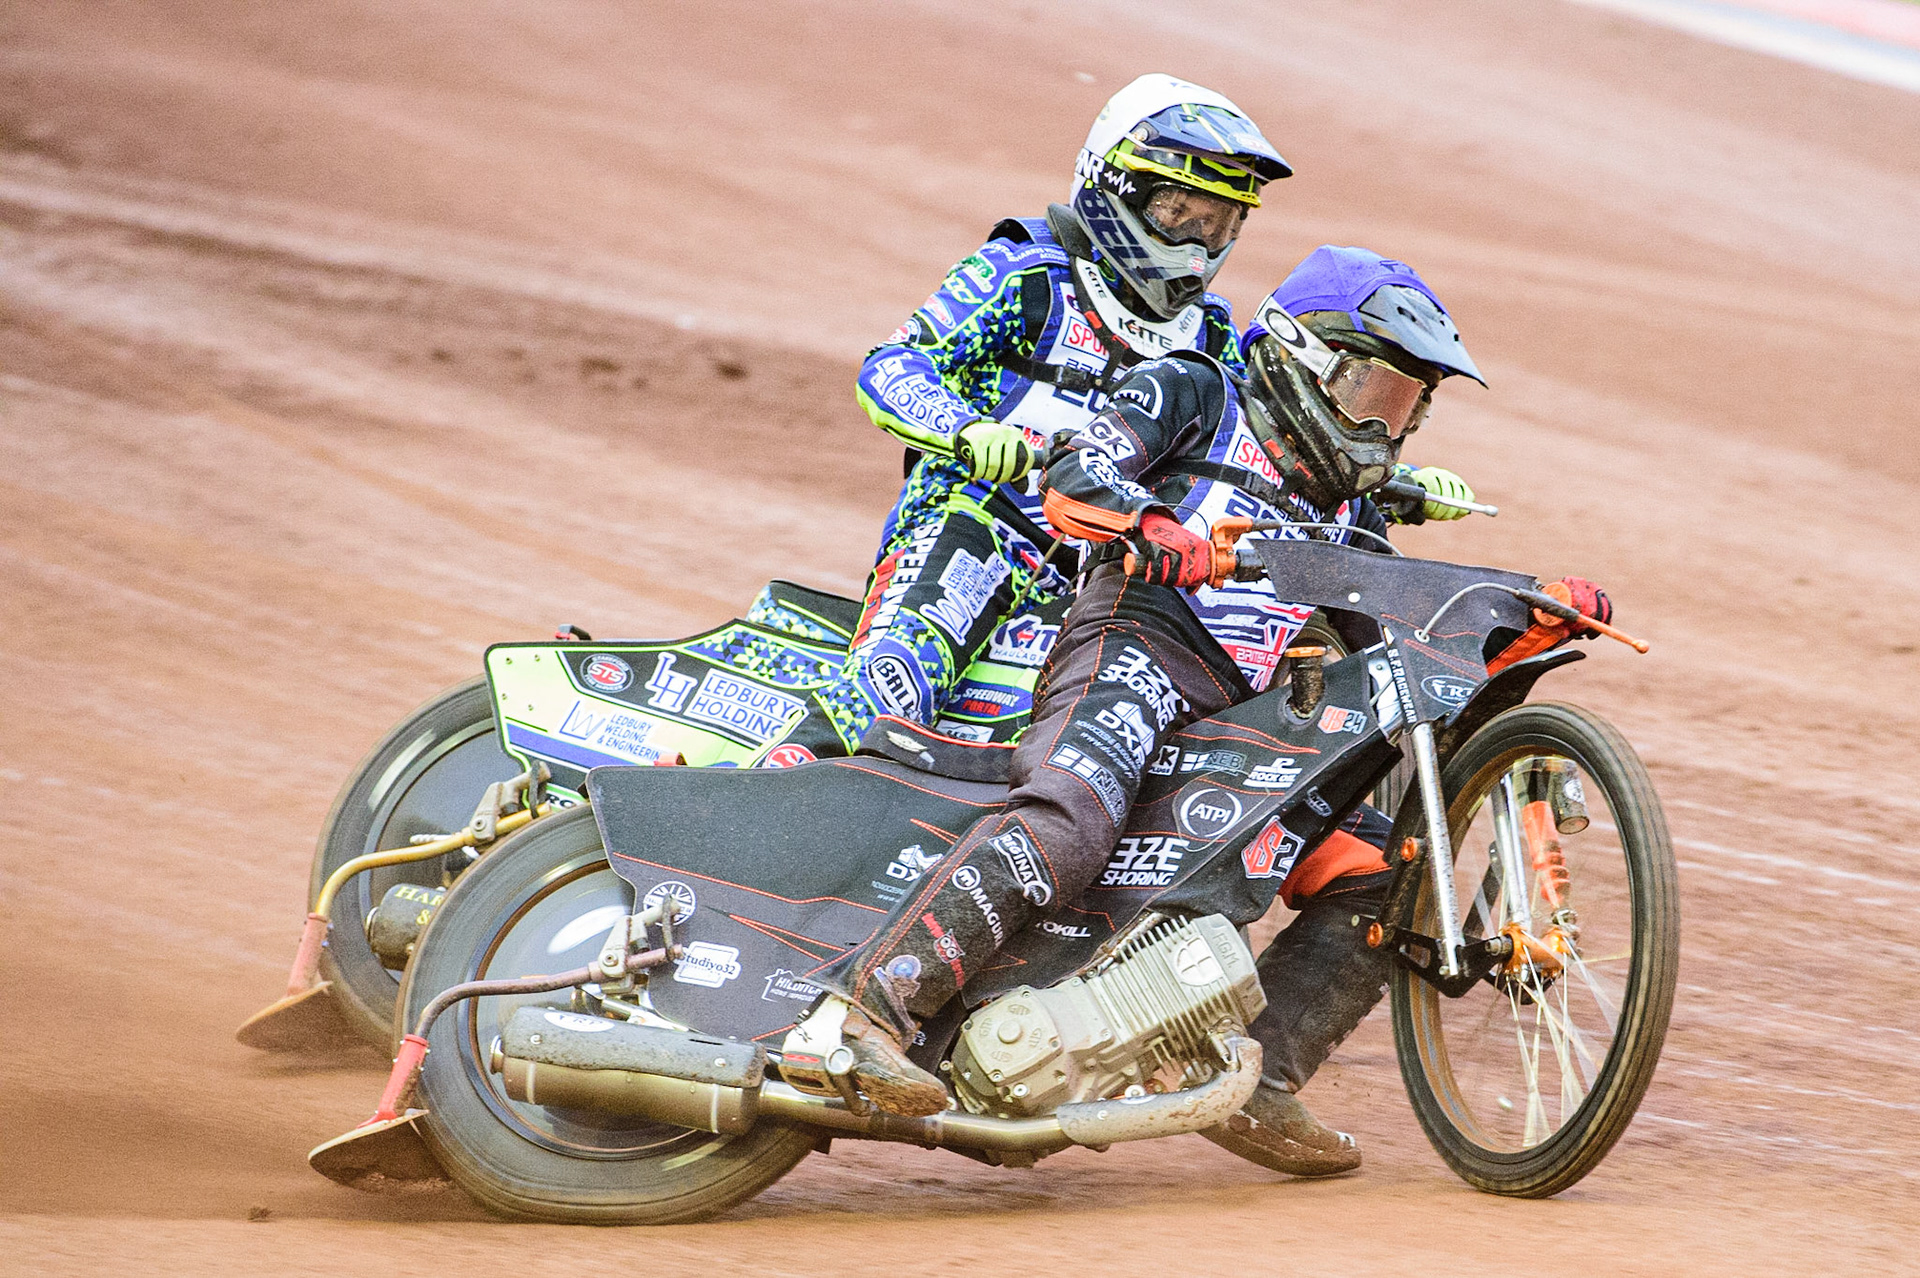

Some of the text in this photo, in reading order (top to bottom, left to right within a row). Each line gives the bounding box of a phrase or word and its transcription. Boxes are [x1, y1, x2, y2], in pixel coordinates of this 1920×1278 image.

[1085, 266, 1107, 299] KITE
[1178, 308, 1196, 334] KITE
[1118, 317, 1173, 351] KITE
[945, 554, 973, 589] LEDBURY
[958, 563, 984, 598] WELDING
[590, 664, 623, 682] STS
[703, 677, 795, 719] LEDBURY
[962, 699, 1002, 716] PORTAL
[963, 688, 1019, 707] SPEEDWAY
[610, 713, 653, 732] LEDBURY
[605, 724, 646, 743] WELDING
[605, 737, 660, 760] ENGINEERIN
[1250, 771, 1297, 782] ROCK OIL
[1189, 802, 1232, 823] ATPI
[1000, 833, 1035, 882] REGINA
[1100, 870, 1175, 886] SHORING
[684, 955, 736, 975] tudiyo32
